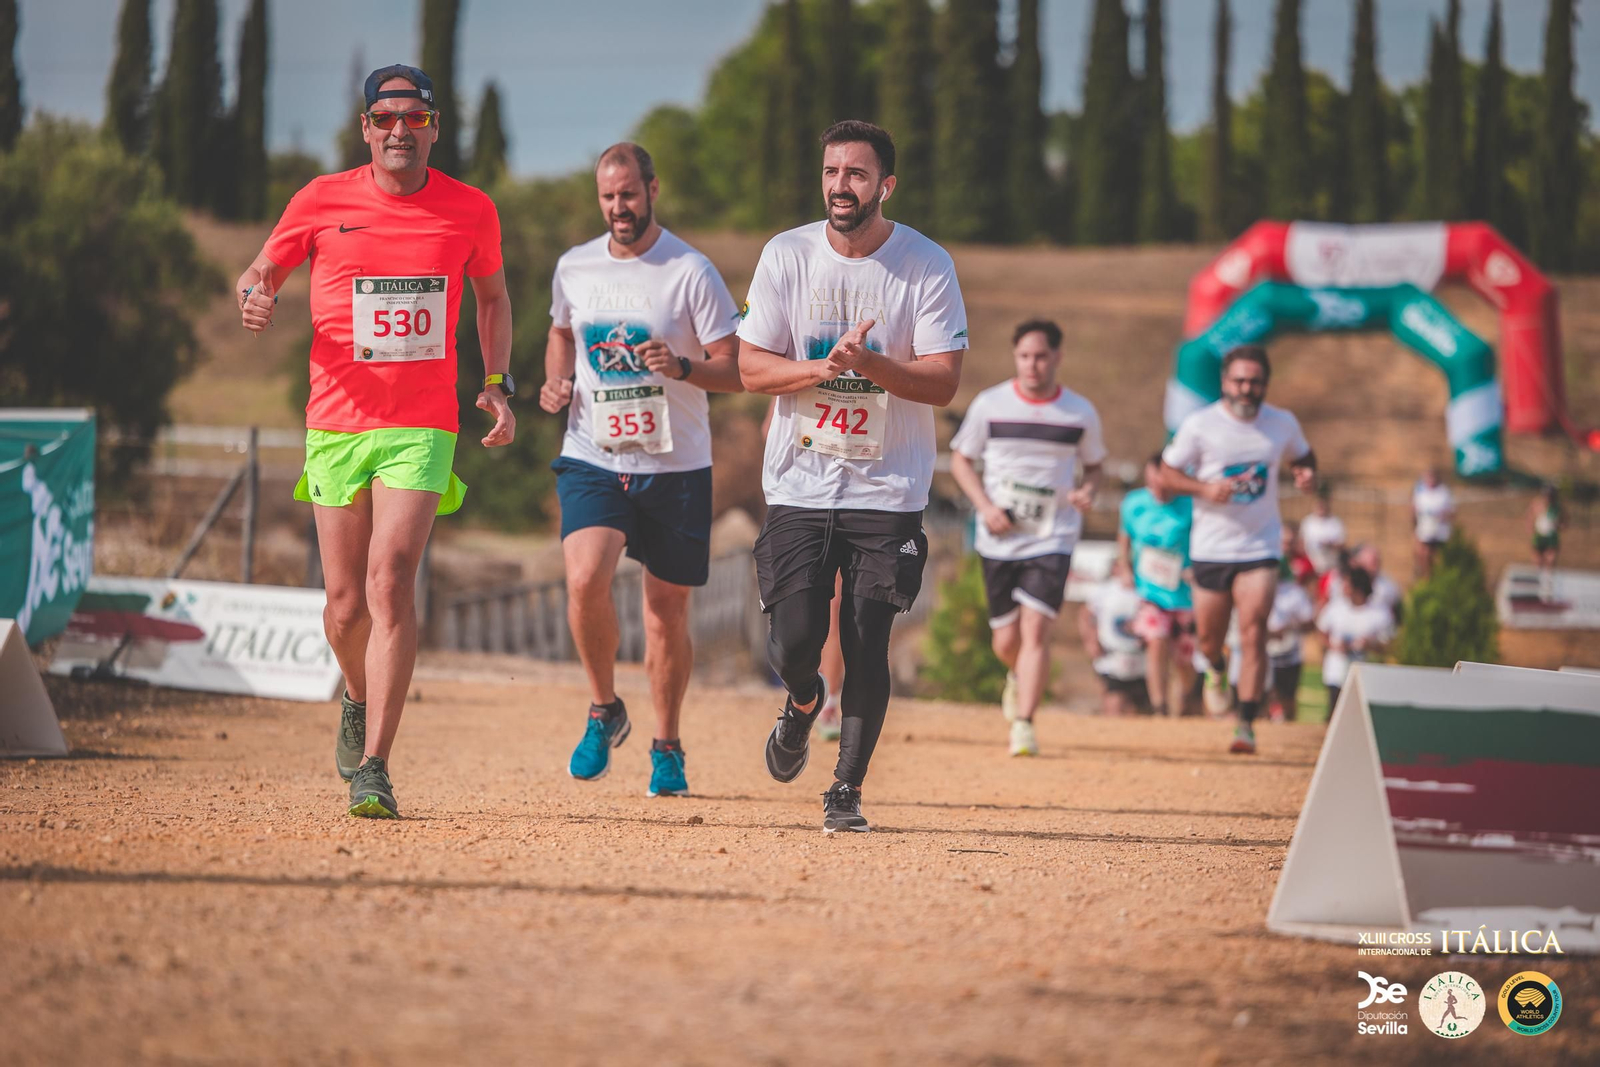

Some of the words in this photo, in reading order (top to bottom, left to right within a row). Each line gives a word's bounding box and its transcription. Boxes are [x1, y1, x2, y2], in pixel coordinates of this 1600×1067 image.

[380, 279, 424, 291] ITÁLICA
[811, 288, 847, 302] XLIII
[847, 290, 879, 302] CROSS
[373, 308, 432, 338] 530
[608, 411, 656, 437] 353
[815, 402, 869, 435] 742
